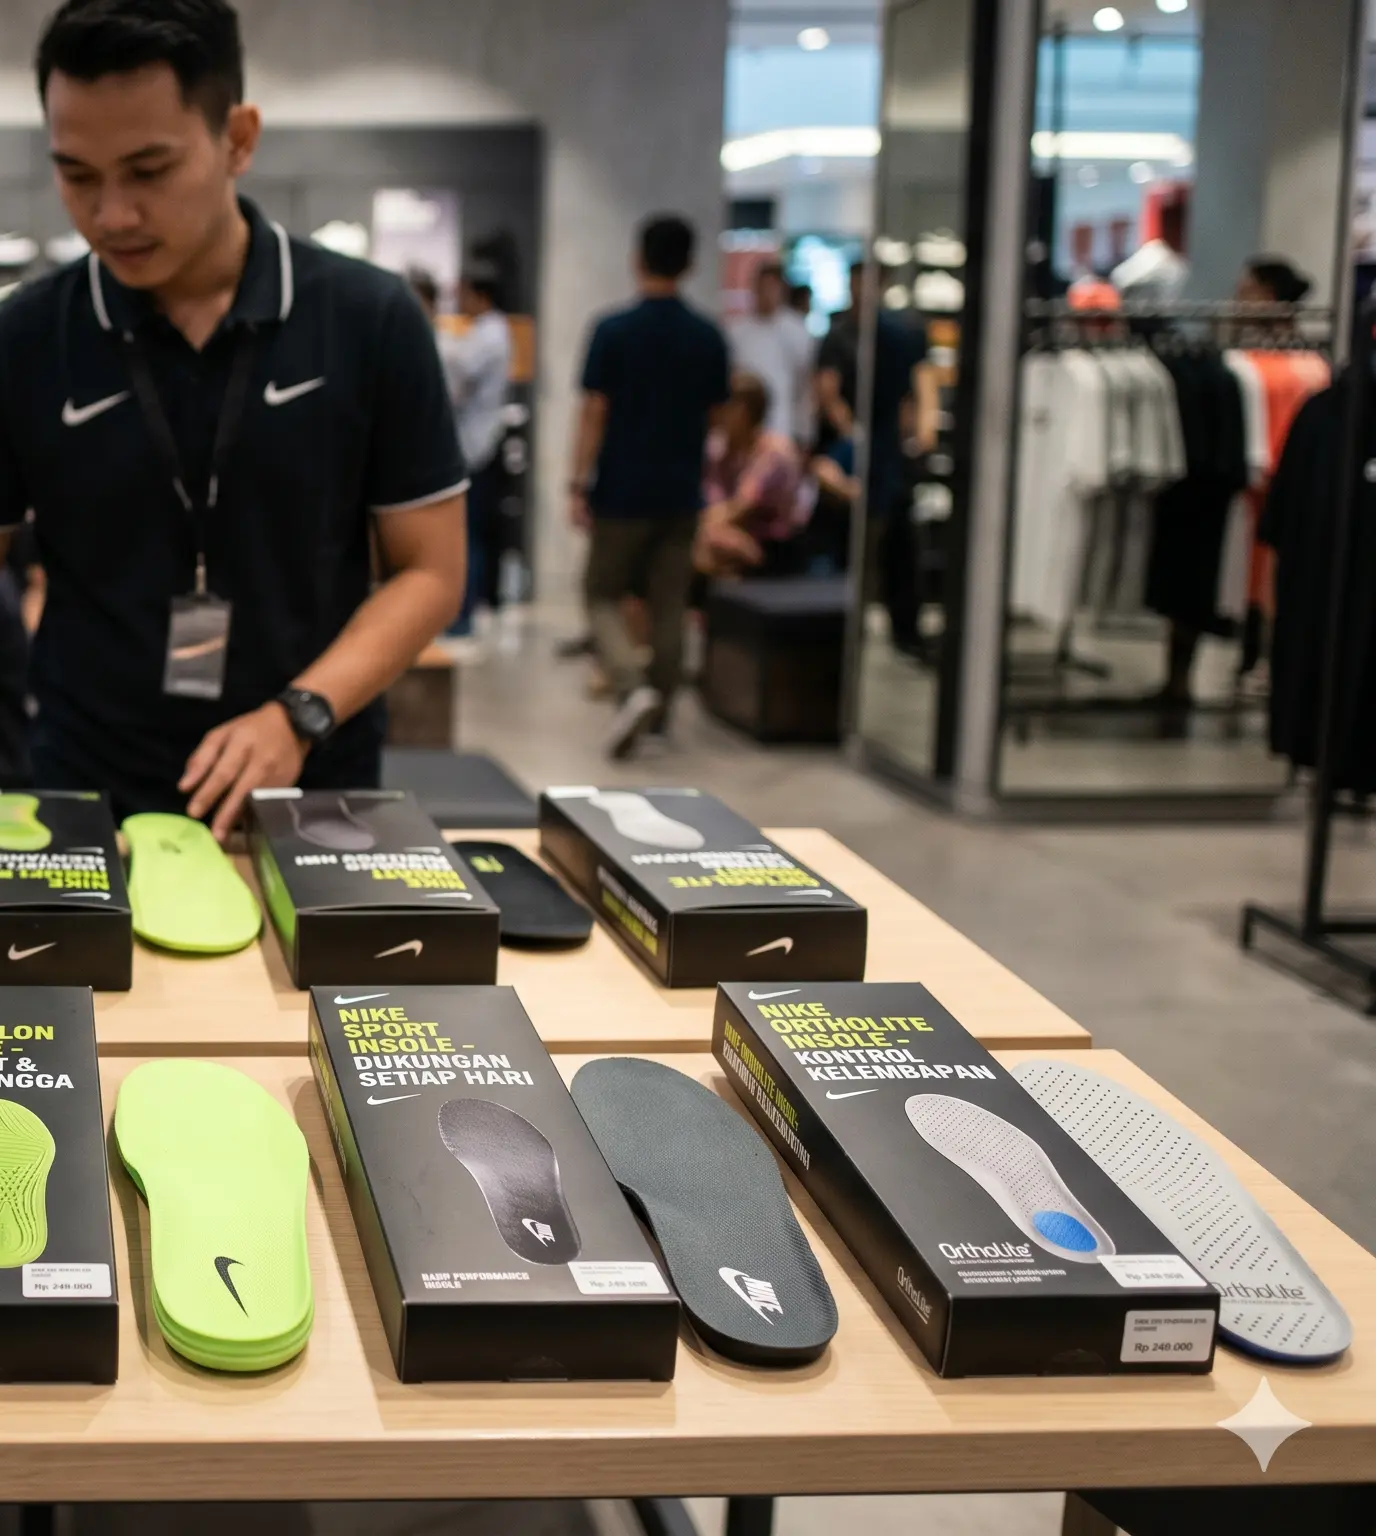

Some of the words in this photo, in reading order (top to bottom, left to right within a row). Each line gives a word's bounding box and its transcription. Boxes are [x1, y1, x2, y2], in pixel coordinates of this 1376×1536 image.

[338, 1007, 409, 1023] NIKE
[757, 1002, 831, 1019] NIKE
[343, 1022, 439, 1038] SPORT
[769, 1016, 934, 1033] ORTHOLITE
[348, 1037, 456, 1054] INSOLE
[780, 1032, 893, 1049] INSOLE
[15, 1057, 39, 1072] &
[352, 1054, 511, 1071] DUKUNGAN
[793, 1049, 924, 1065] KONTROL
[359, 1070, 457, 1087] SETIAP
[465, 1070, 535, 1086] HARI
[804, 1064, 997, 1081] KELEMBAPAN
[1134, 1343, 1149, 1353] Rp
